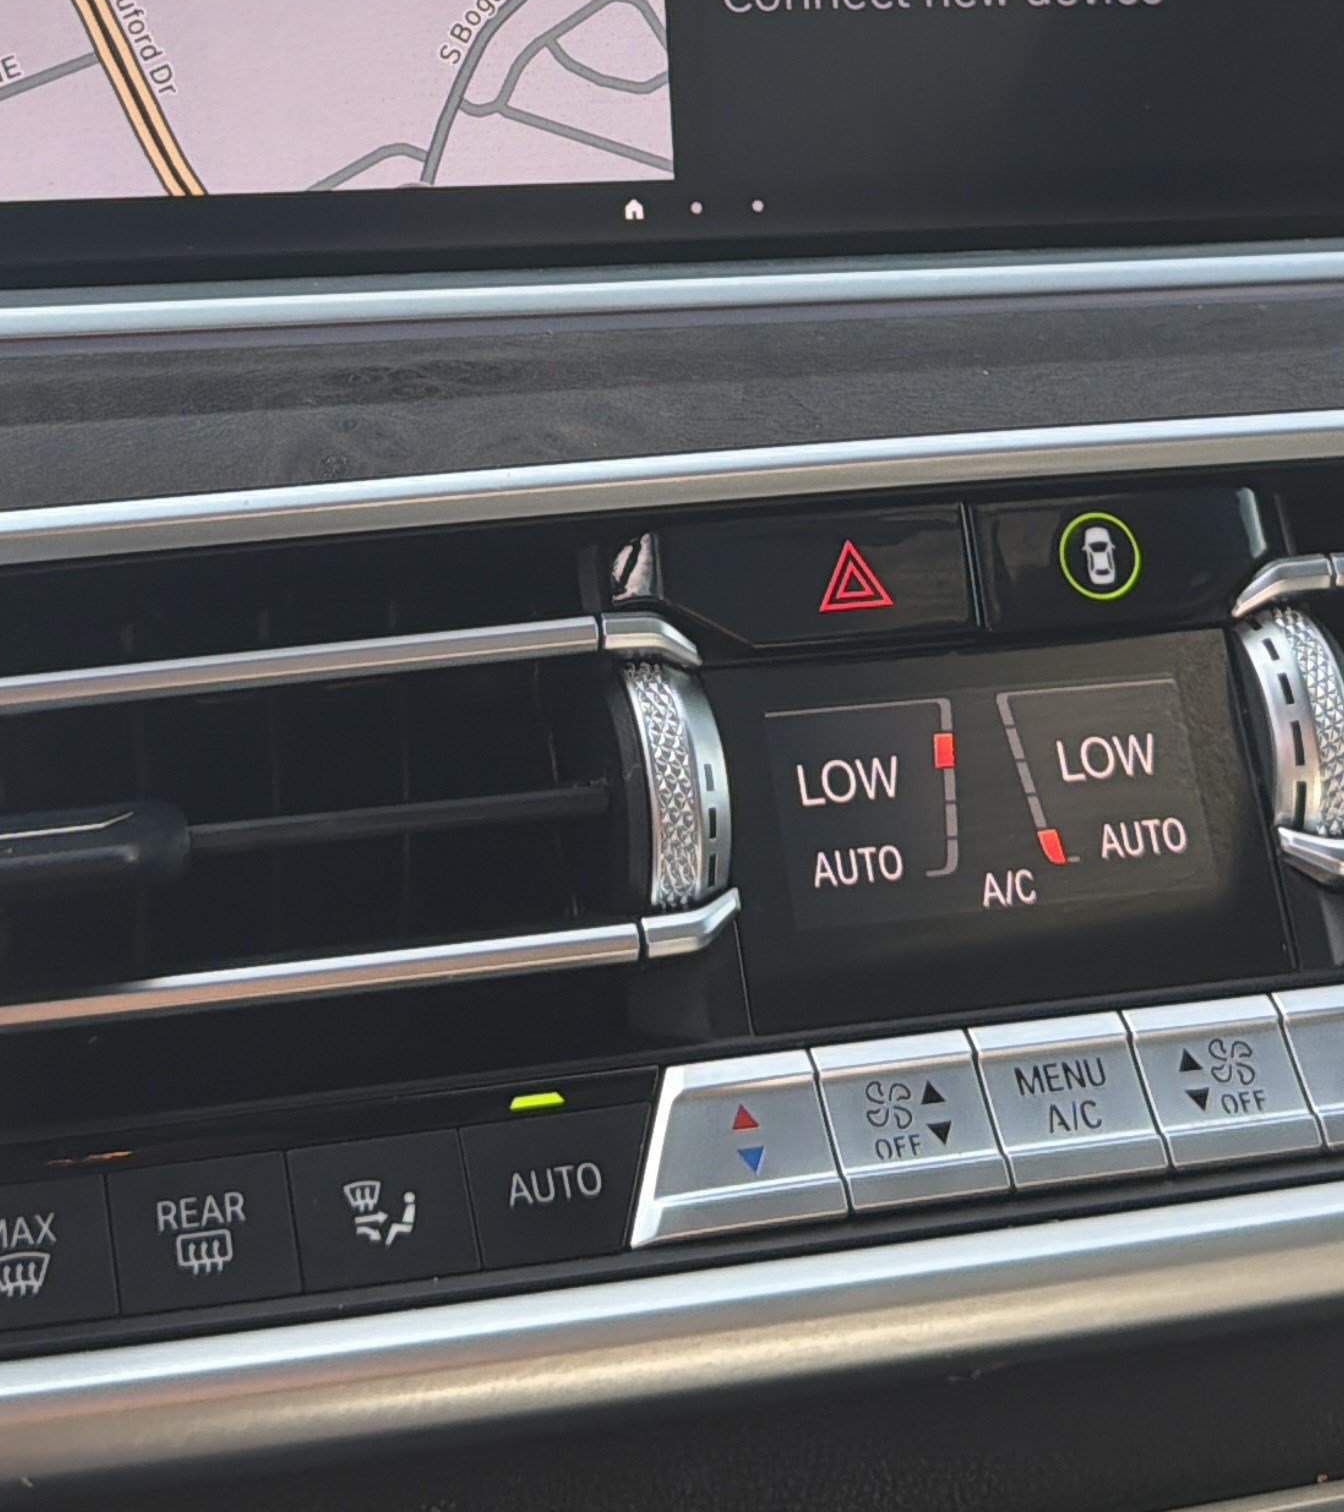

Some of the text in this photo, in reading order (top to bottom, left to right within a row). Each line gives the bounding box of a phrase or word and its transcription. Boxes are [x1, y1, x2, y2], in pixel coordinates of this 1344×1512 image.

[440, 45, 461, 64] S
[149, 65, 177, 94] Dr
[1056, 732, 1155, 783] LOW
[796, 756, 899, 807] LOW
[1101, 817, 1188, 859] AUTO
[813, 845, 904, 888] AUTO
[983, 869, 1037, 908] A/C
[1014, 1058, 1106, 1096] MENU
[1048, 1100, 1103, 1134] A/C
[1220, 1089, 1266, 1115] OFF
[874, 1133, 922, 1161] OFF
[509, 1161, 603, 1208] AUTO
[156, 1191, 246, 1232] REAR
